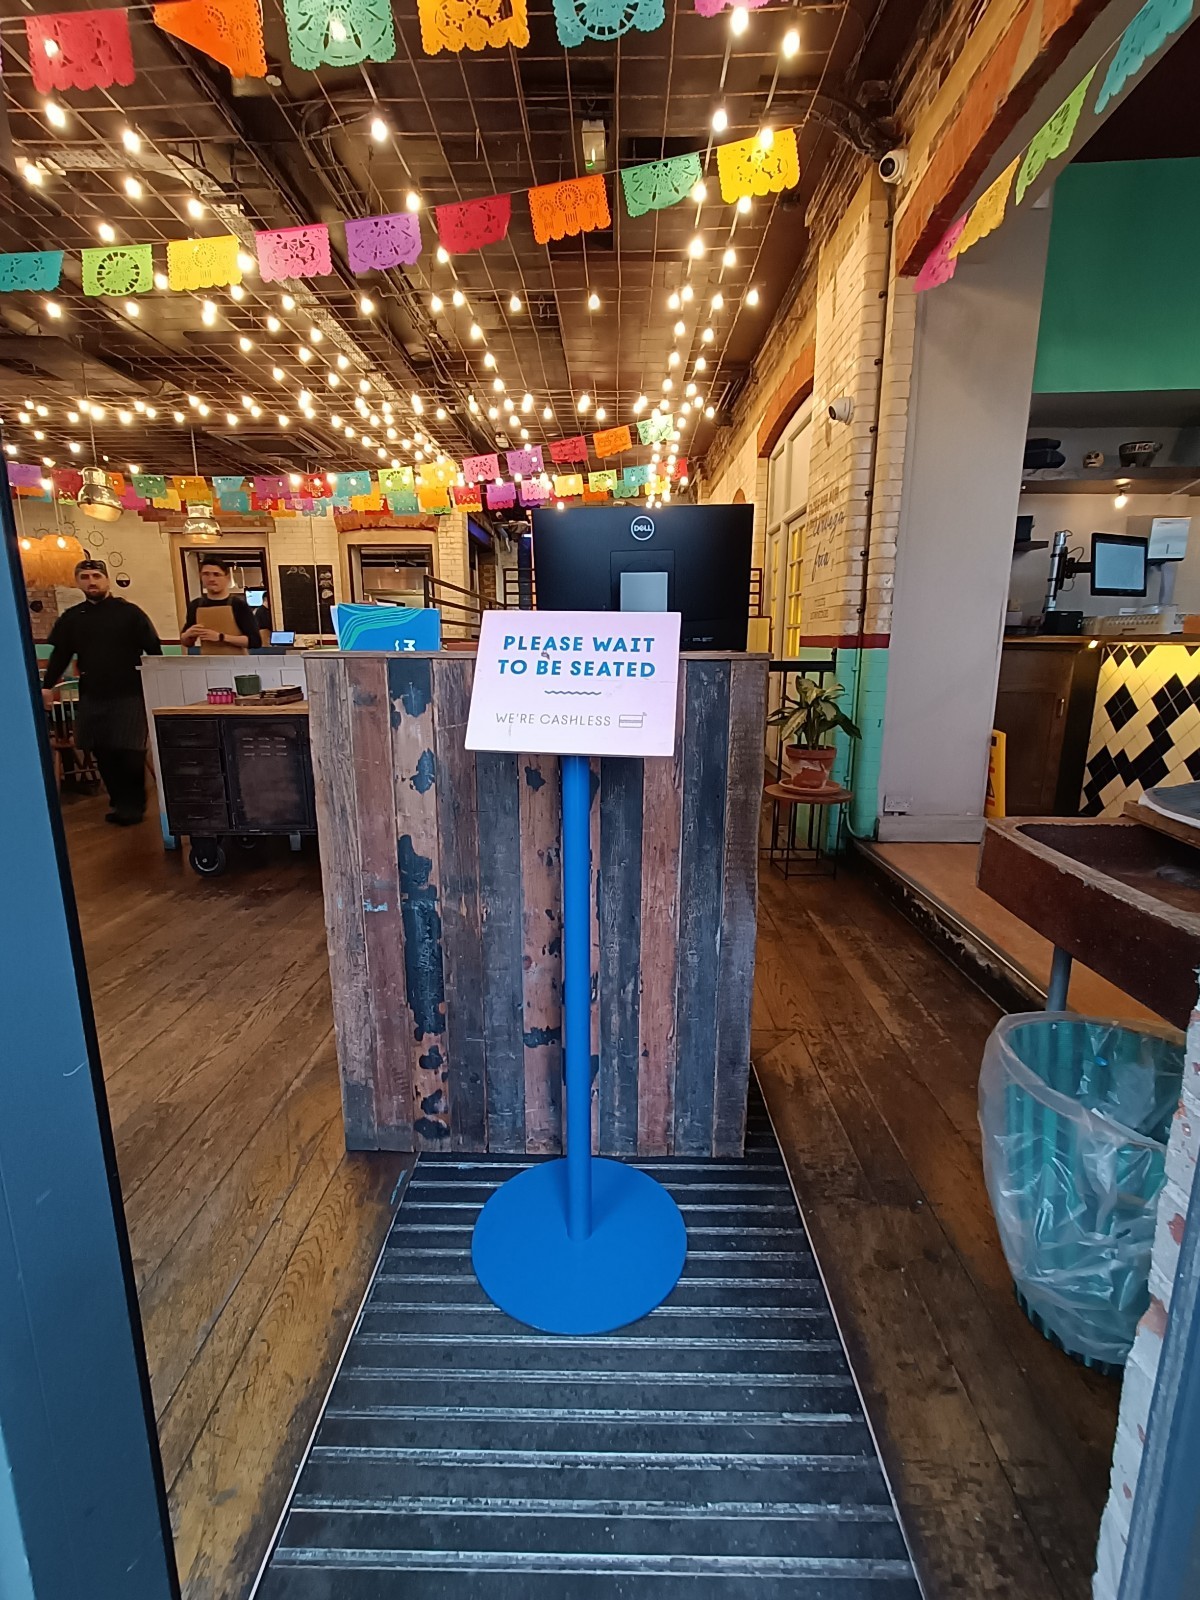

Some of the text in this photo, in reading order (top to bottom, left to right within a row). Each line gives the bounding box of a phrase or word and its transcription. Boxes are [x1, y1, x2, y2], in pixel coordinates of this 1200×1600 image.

[633, 524, 652, 532] DELL
[503, 635, 655, 653] PLEASE WAIT
[498, 659, 656, 678] TO BE SEATED
[495, 713, 611, 727] WE'RE CASHLESS
